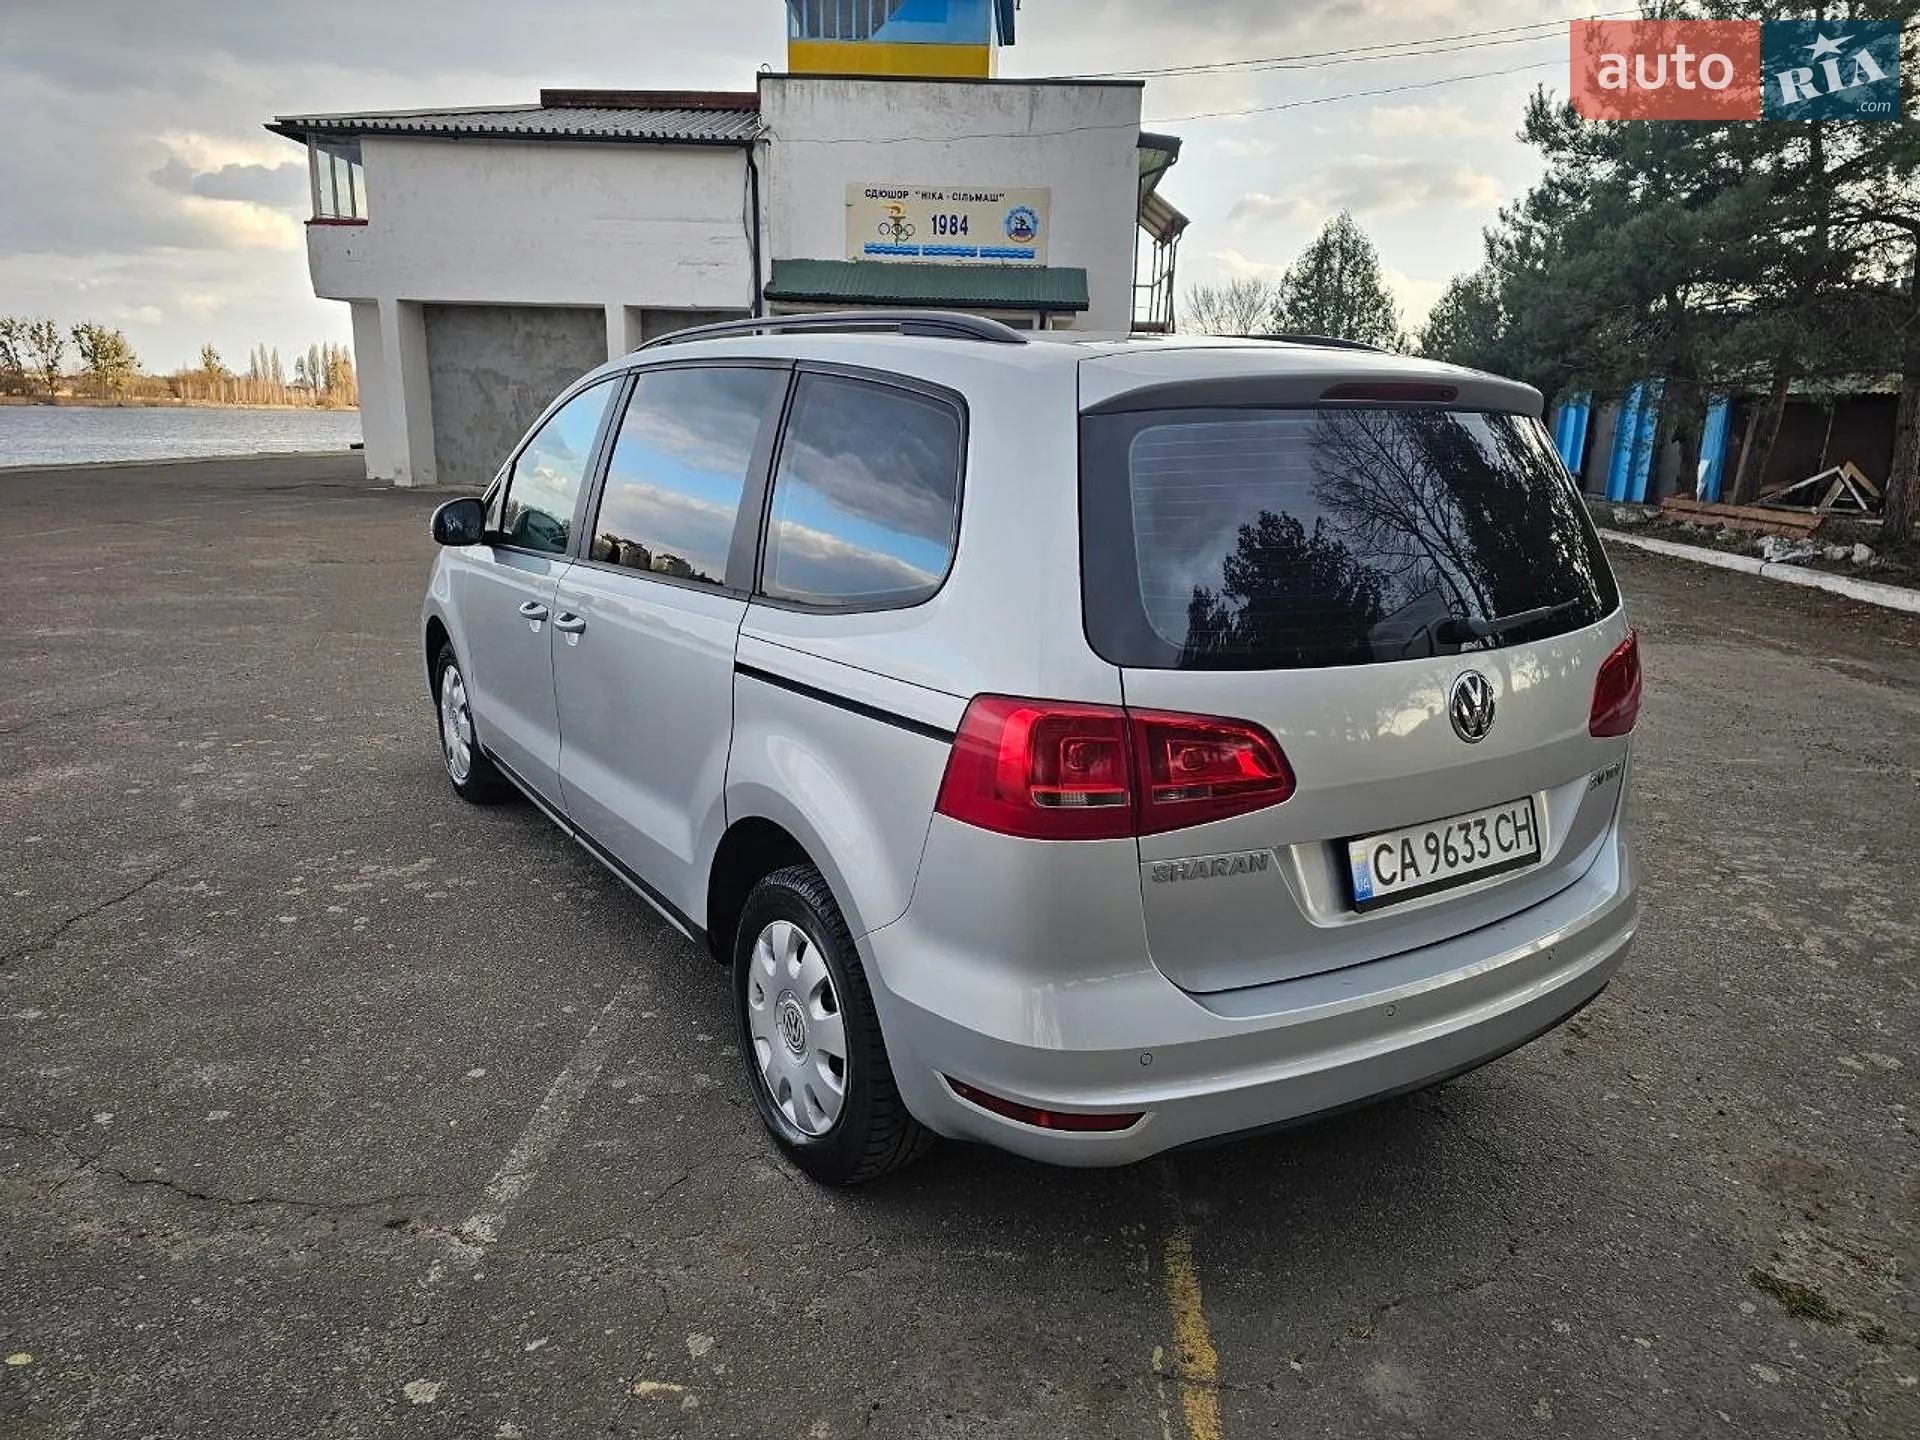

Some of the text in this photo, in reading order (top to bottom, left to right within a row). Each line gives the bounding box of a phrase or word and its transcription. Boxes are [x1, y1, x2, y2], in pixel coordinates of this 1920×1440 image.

[865, 189, 909, 199] СДЮШОР
[931, 214, 969, 236] 1984
[1373, 807, 1533, 886] CA 9633 CH
[1151, 853, 1269, 883] SHARAN
[1356, 880, 1372, 893] UA
